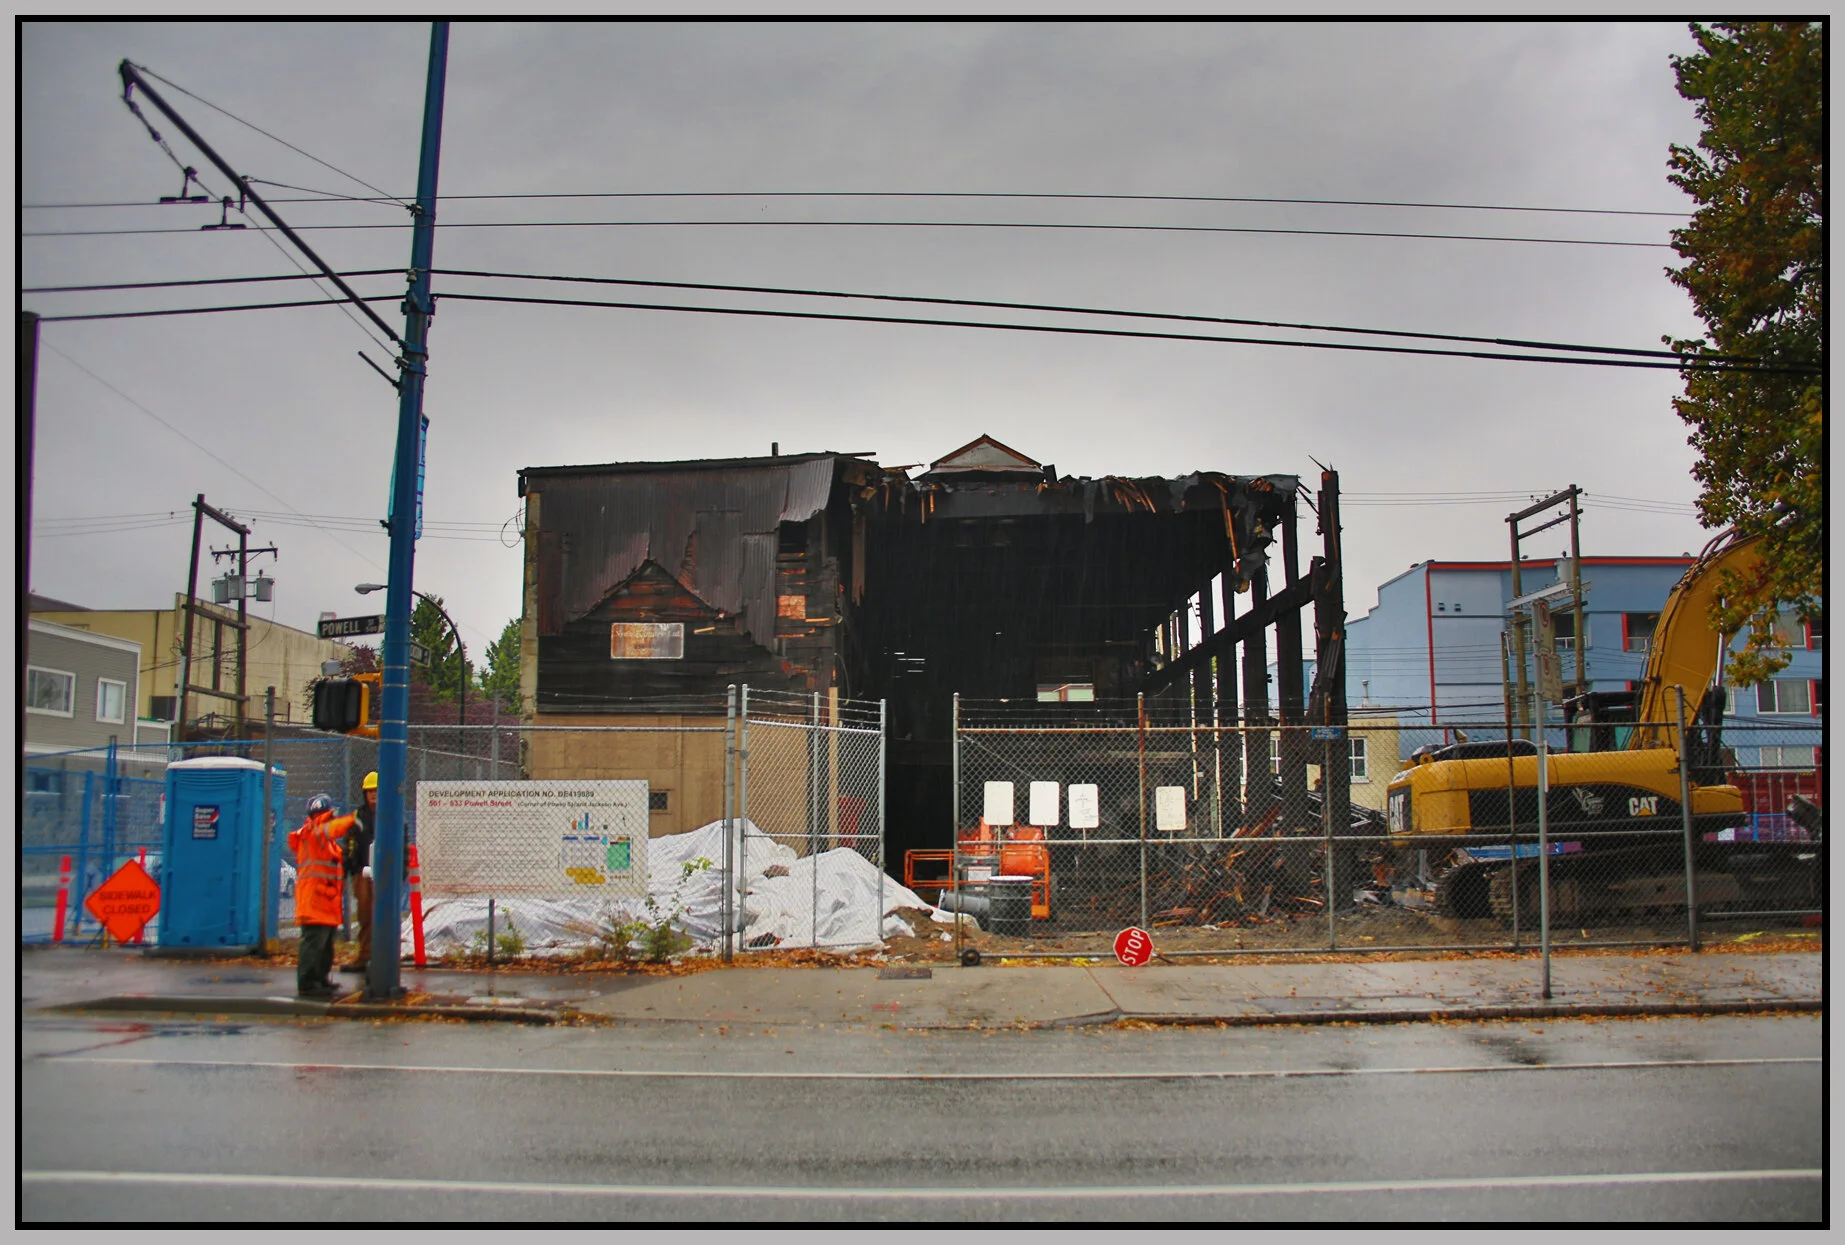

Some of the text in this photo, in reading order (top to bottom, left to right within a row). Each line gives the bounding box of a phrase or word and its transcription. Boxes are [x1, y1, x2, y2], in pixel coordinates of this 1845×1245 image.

[322, 620, 361, 635] POWELL
[1389, 793, 1405, 833] CAT
[1628, 796, 1658, 816] CAT
[99, 890, 157, 901] SIDEWALK
[103, 904, 151, 914] CLOSED
[1121, 929, 1145, 965] STOP
